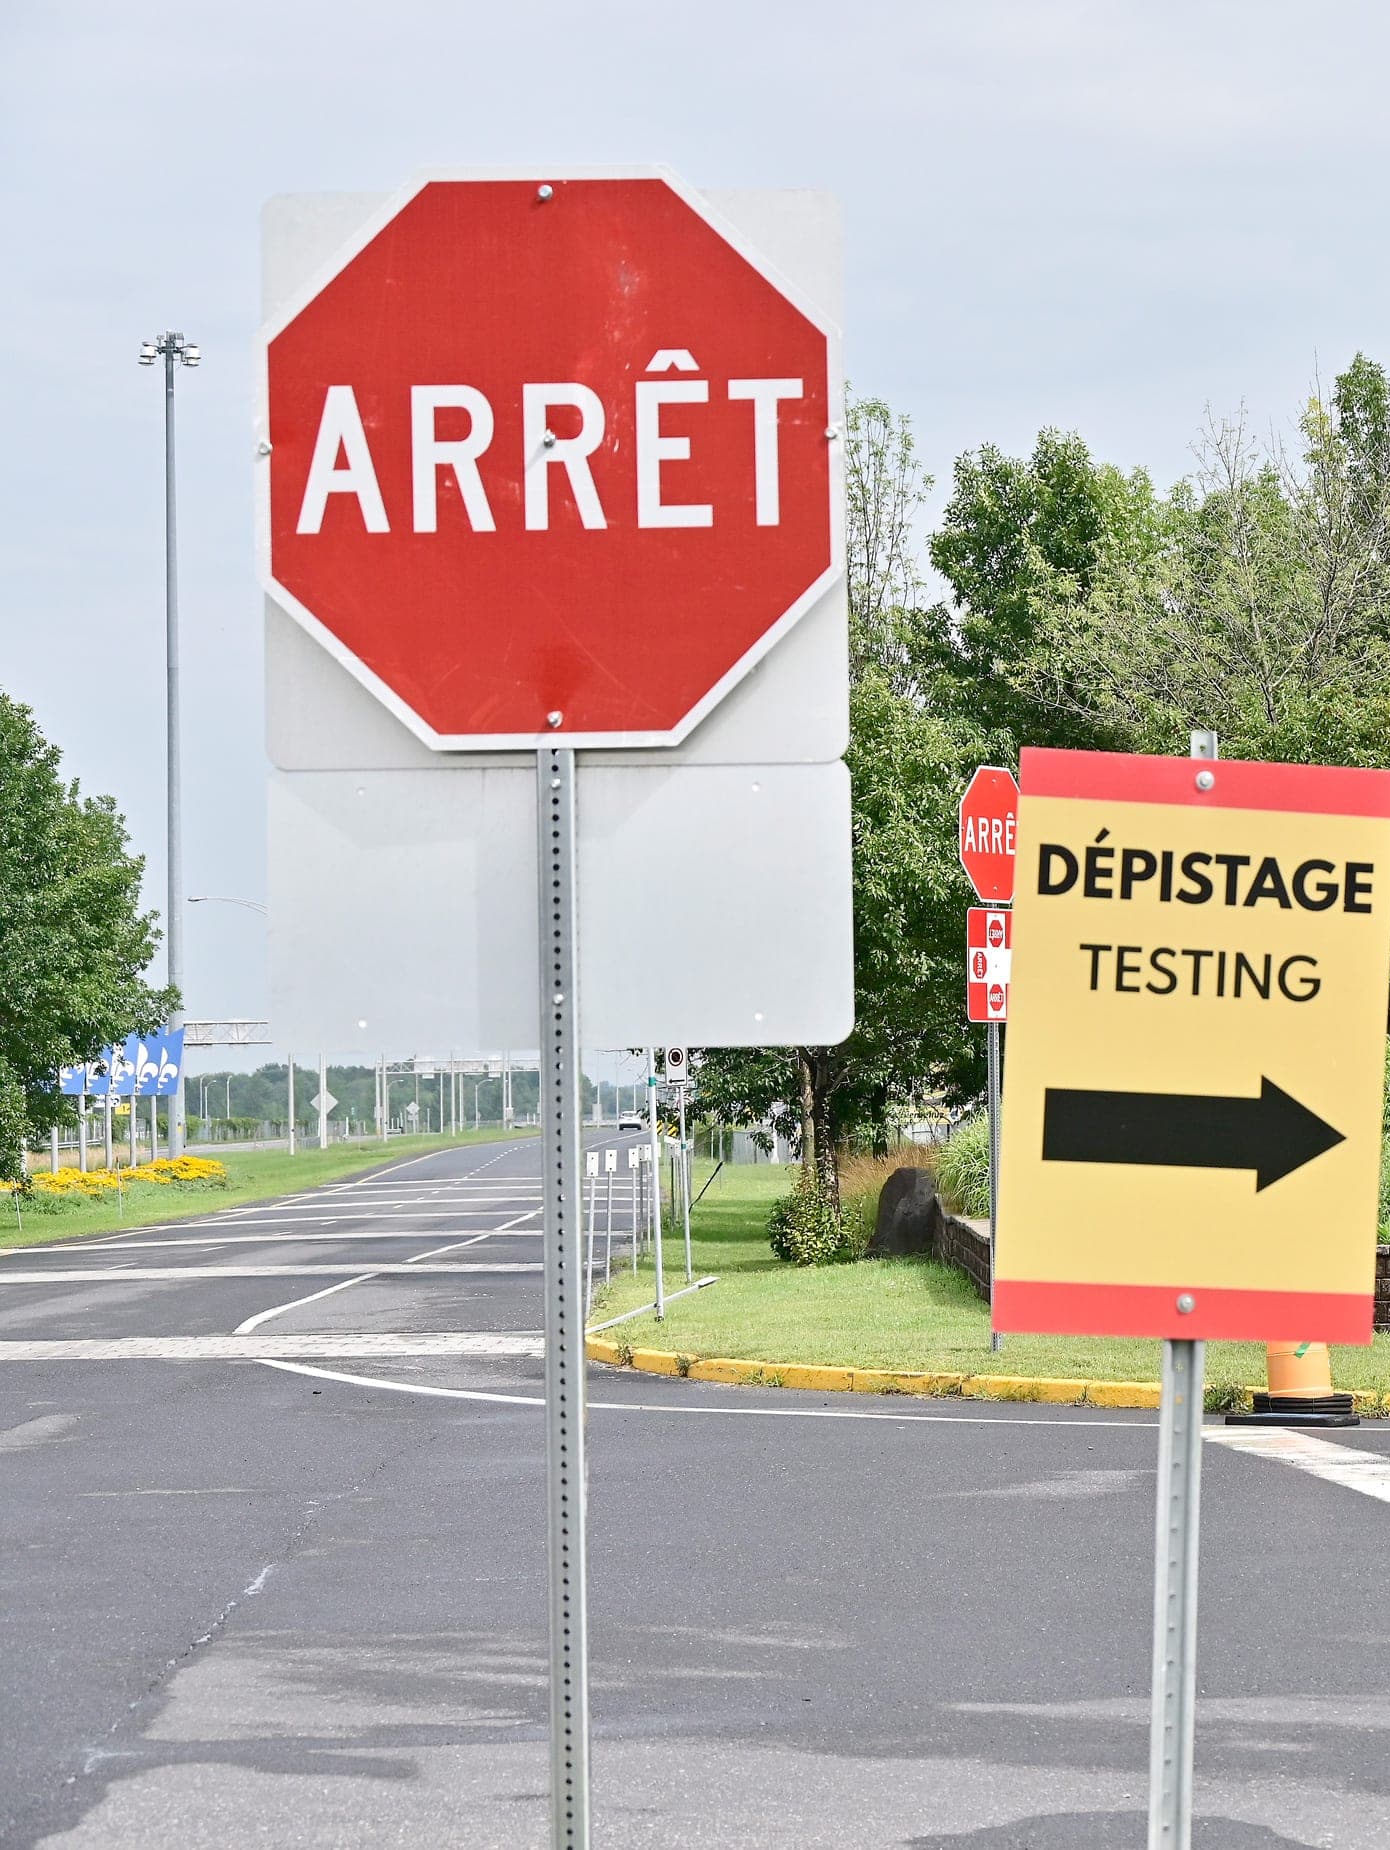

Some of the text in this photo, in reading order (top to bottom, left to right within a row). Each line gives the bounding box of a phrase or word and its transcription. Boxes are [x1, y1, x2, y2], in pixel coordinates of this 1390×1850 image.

[296, 348, 804, 535] ARRÊT
[963, 811, 1018, 856] ARRÊ
[1037, 827, 1375, 915] DÉPISTAGE
[1079, 943, 1322, 1003] TESTING
